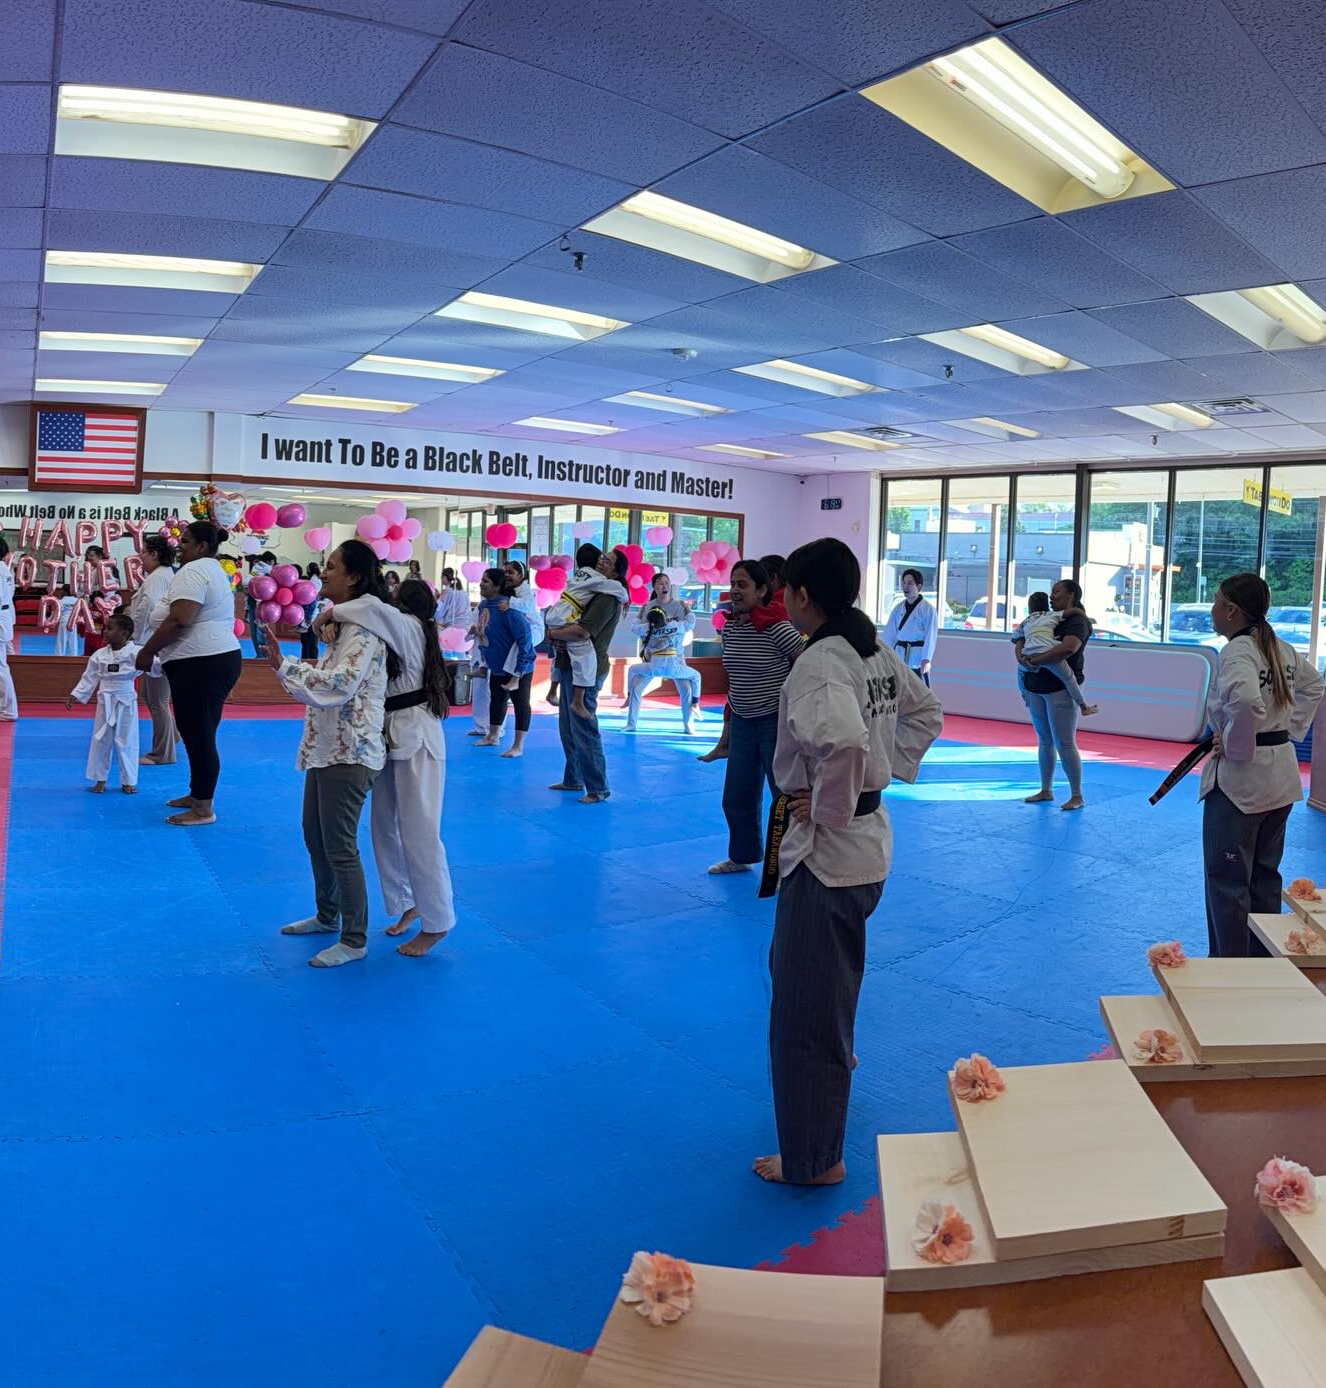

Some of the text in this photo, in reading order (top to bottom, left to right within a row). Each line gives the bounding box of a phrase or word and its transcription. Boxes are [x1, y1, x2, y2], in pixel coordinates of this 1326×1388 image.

[261, 433, 734, 499] I want To Be a Black Belt, Instructor and Master!
[17, 516, 147, 558] HAPPY
